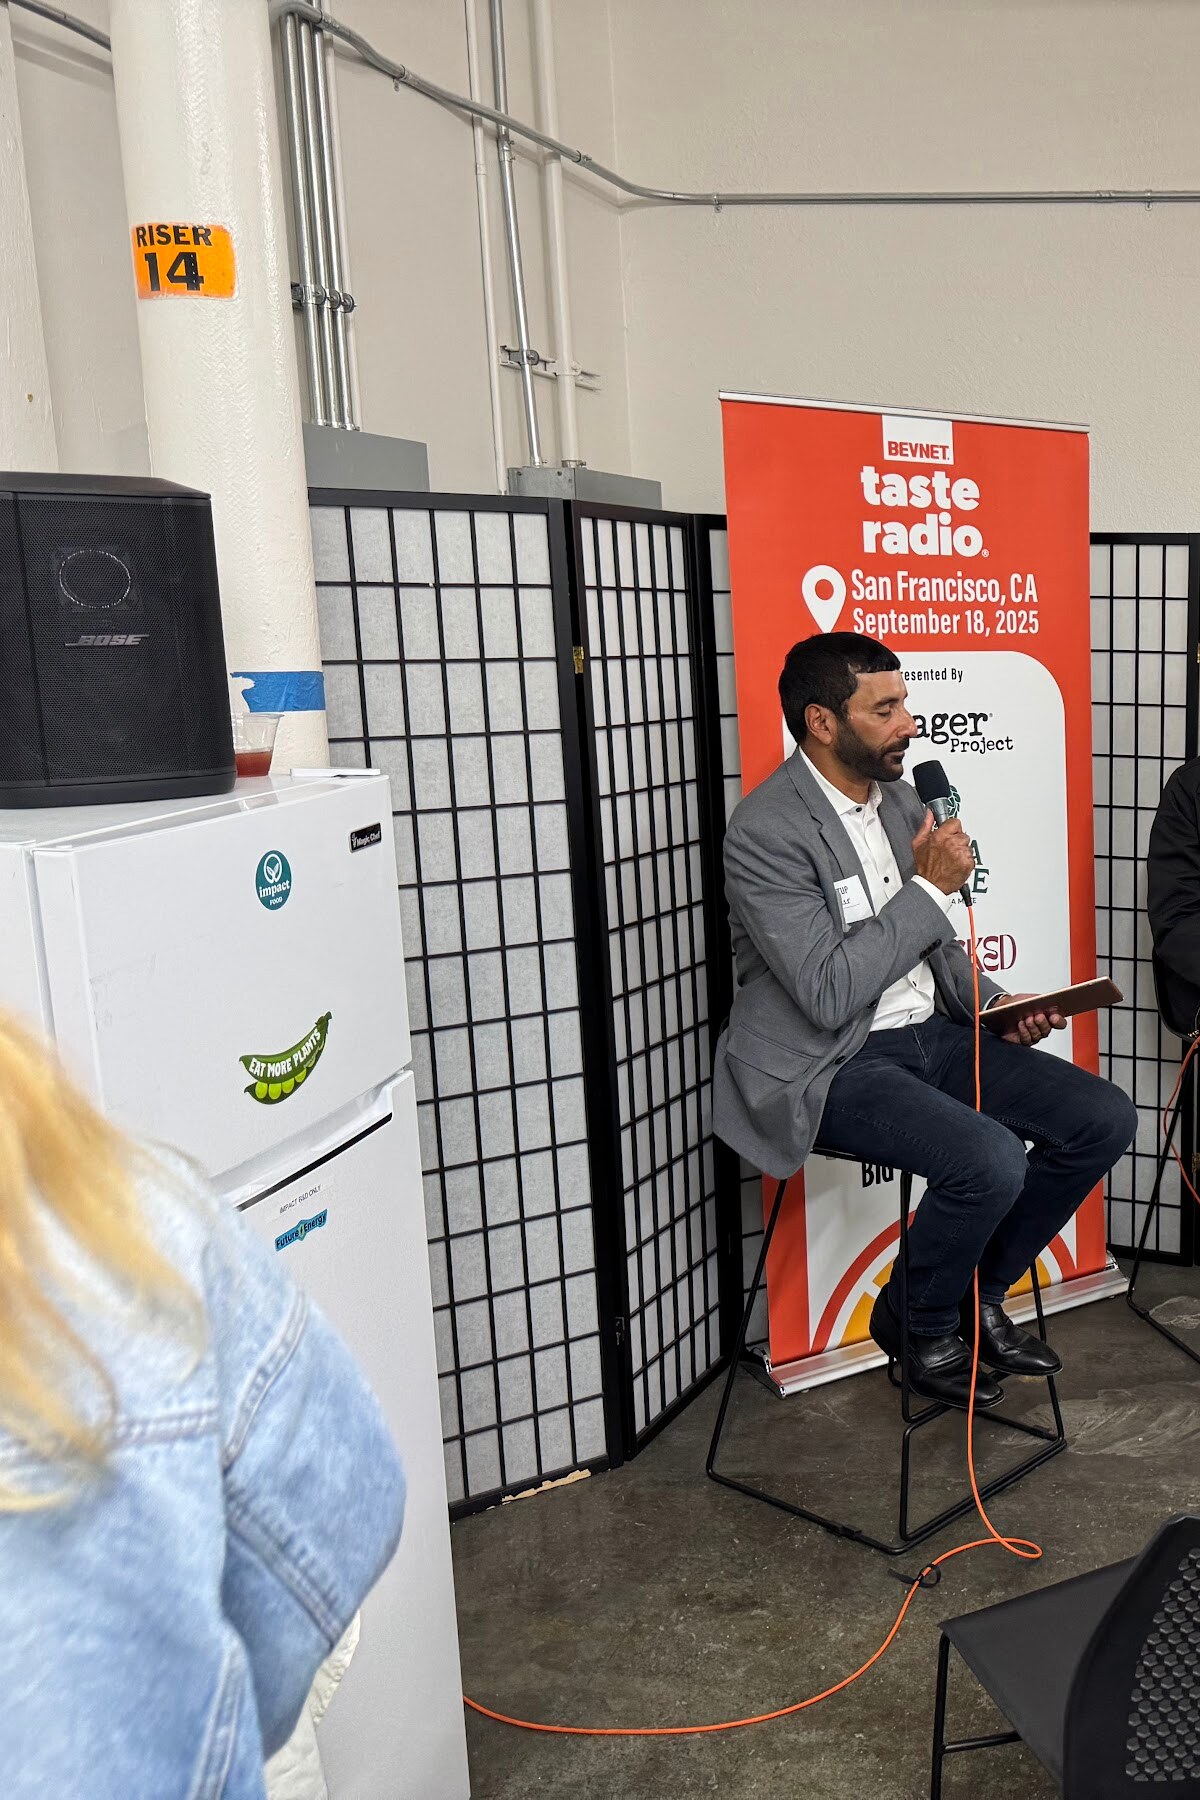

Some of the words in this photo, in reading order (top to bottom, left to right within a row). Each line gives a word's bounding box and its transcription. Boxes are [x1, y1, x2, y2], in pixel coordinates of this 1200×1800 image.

[136, 224, 213, 248] RISER
[144, 251, 205, 292] 14
[860, 465, 980, 511] taste
[851, 568, 892, 601] San
[896, 570, 1007, 606] Francisco,
[1009, 572, 1039, 603] CA
[853, 607, 961, 640] September
[964, 609, 991, 638] 18,
[995, 610, 1040, 635] 2025
[65, 634, 150, 646] BOSE
[951, 668, 963, 683] By
[911, 712, 989, 745] ager
[950, 736, 1014, 754] Project
[356, 835, 369, 846] Magic
[369, 831, 380, 842] Chef
[259, 879, 290, 898] impact
[269, 896, 283, 906] FOOD
[249, 1057, 266, 1078] EAT
[267, 1057, 292, 1078] MORE
[292, 1028, 321, 1067] PLANTS
[280, 1198, 298, 1214] IMPACT
[308, 1184, 321, 1197] ONLY
[276, 1230, 299, 1249] Future
[303, 1214, 326, 1233] Energy
